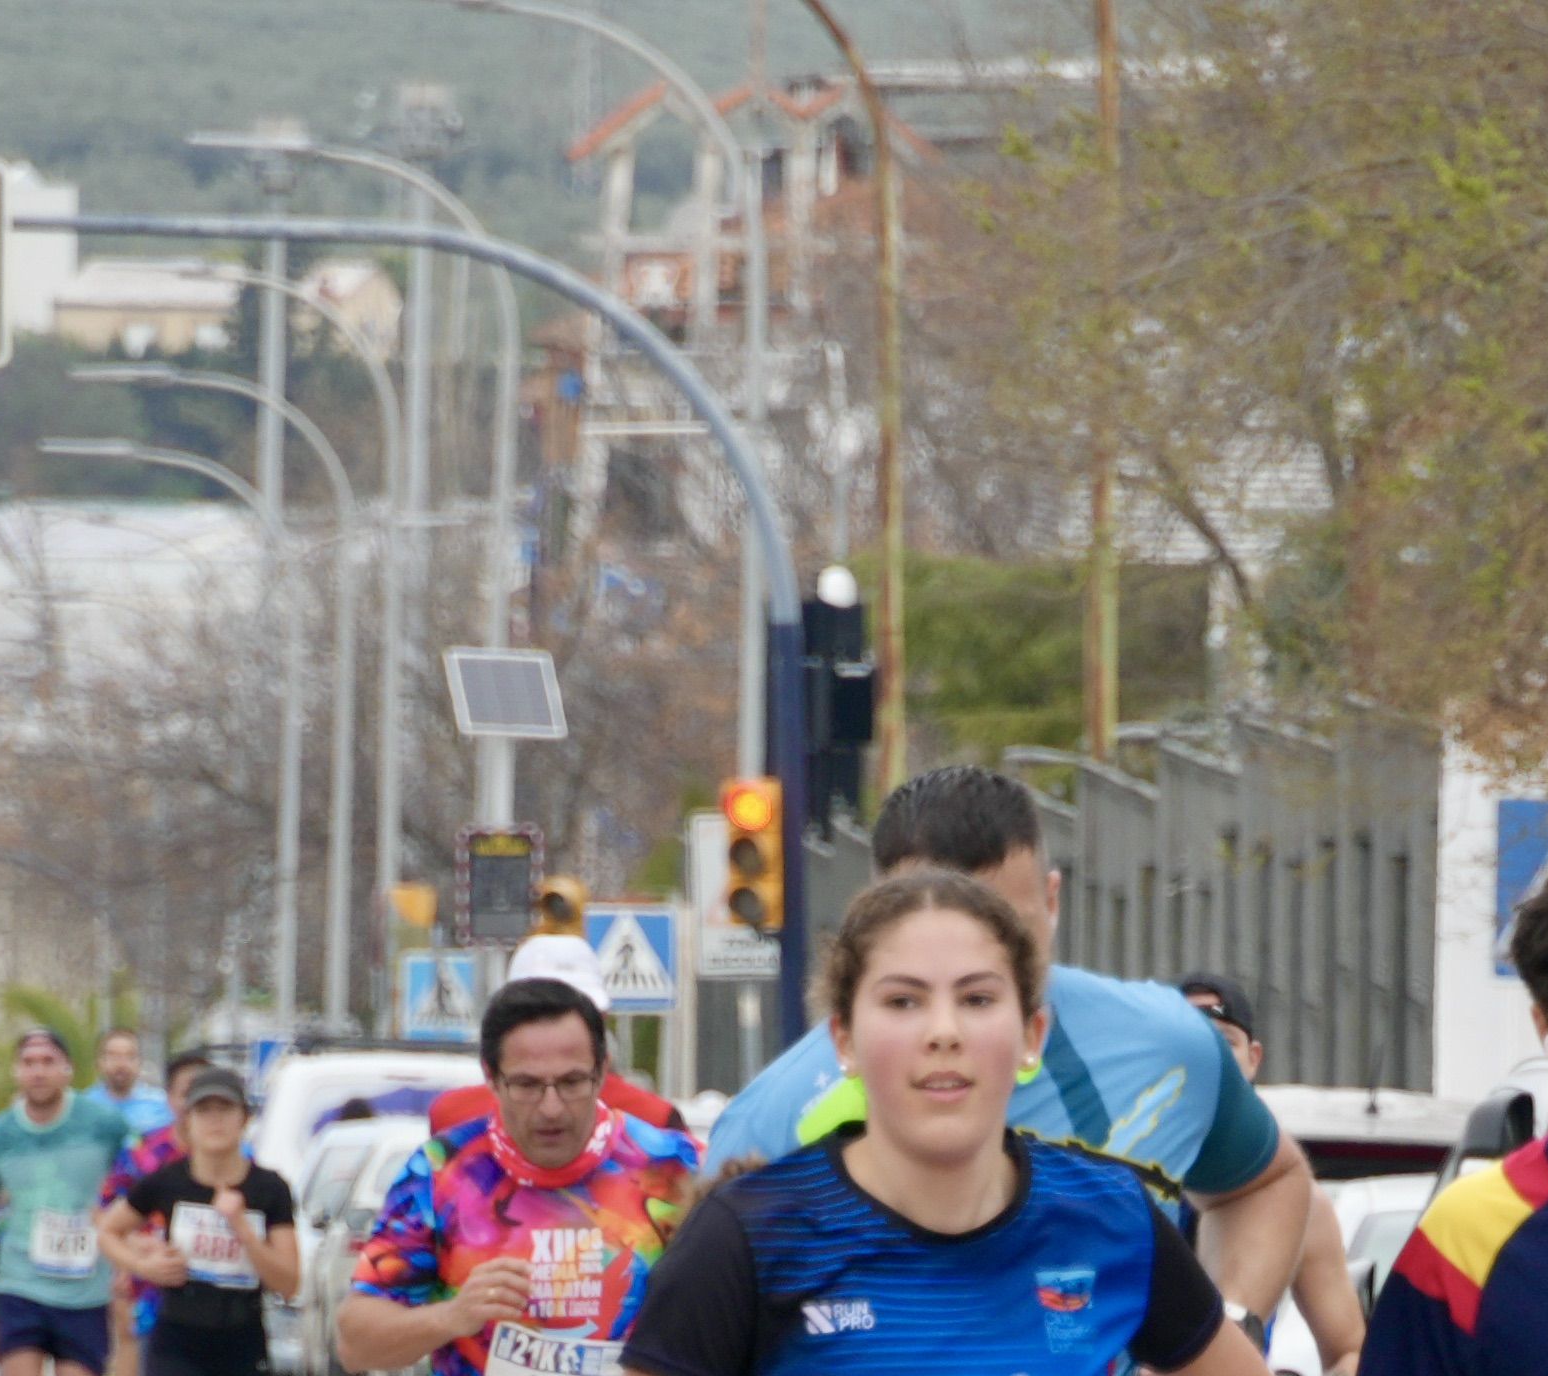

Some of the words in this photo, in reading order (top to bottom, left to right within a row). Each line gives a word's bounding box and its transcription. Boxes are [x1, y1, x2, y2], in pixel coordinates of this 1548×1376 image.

[531, 1229, 576, 1263] XII
[529, 1276, 603, 1299] MARATÓN
[833, 1302, 869, 1318] RUN
[839, 1314, 874, 1330] PRO
